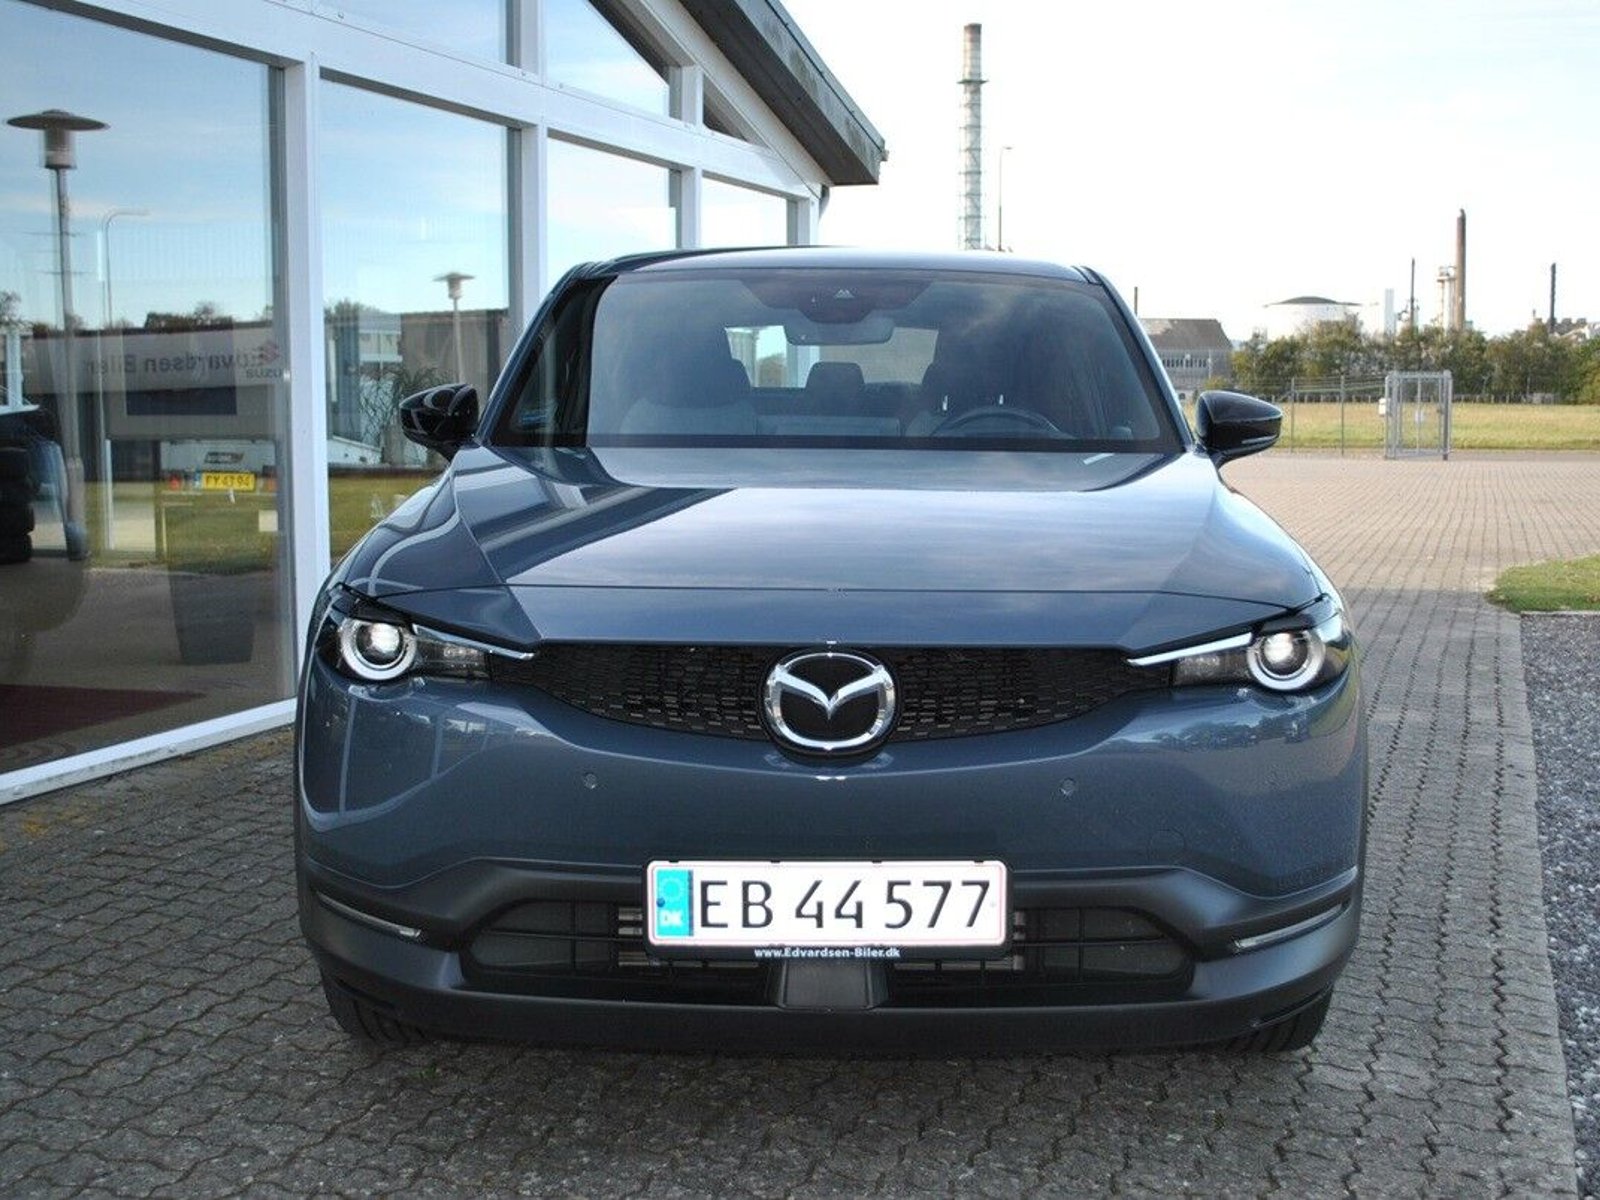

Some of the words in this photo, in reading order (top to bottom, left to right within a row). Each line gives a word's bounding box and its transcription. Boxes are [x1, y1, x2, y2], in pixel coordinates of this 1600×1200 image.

[700, 880, 773, 929] EB
[794, 880, 863, 929] 44
[884, 880, 990, 929] 577
[754, 947, 901, 958] www.Edvardsen-Biler.dk
